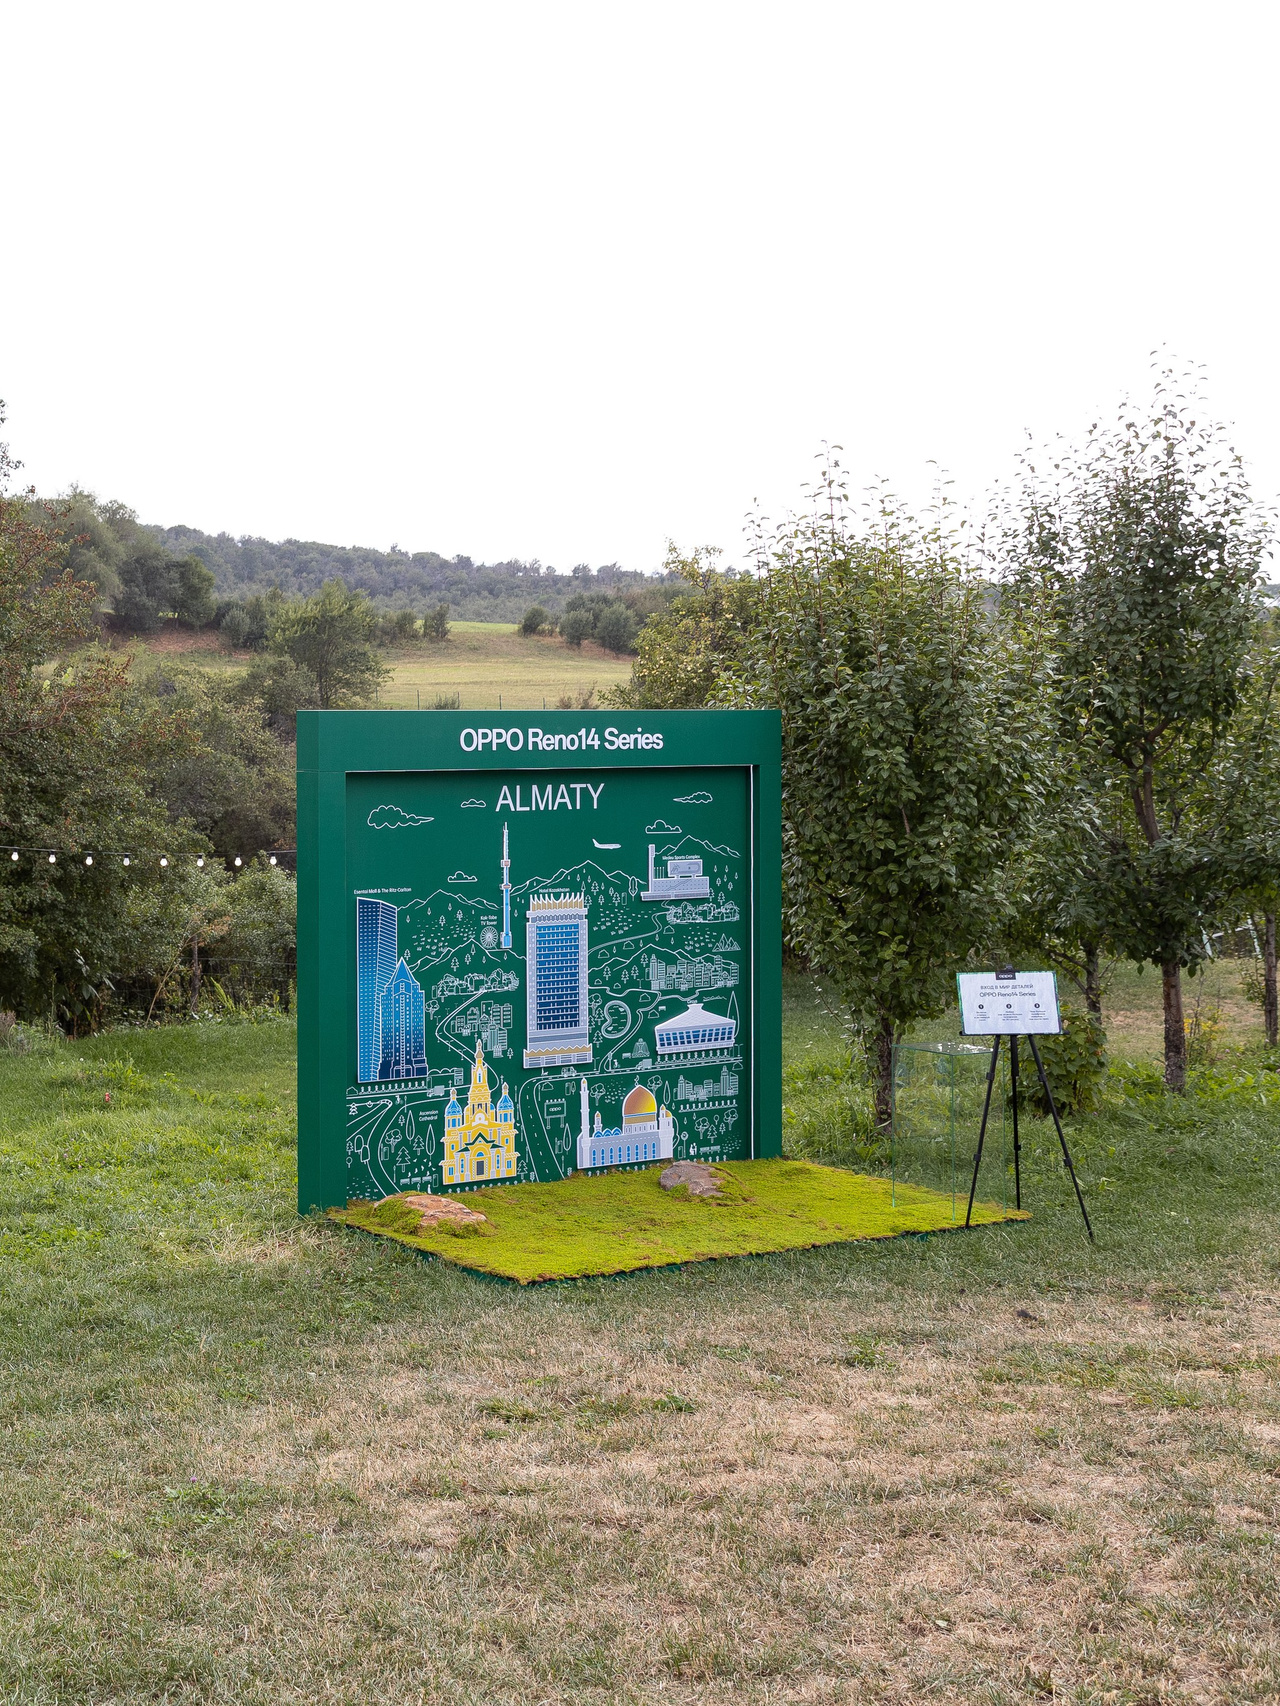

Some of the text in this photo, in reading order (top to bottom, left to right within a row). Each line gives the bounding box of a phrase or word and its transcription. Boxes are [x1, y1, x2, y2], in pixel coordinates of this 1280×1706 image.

[459, 727, 664, 752] OPPO Reno14 Series
[495, 783, 605, 812] ALMATY
